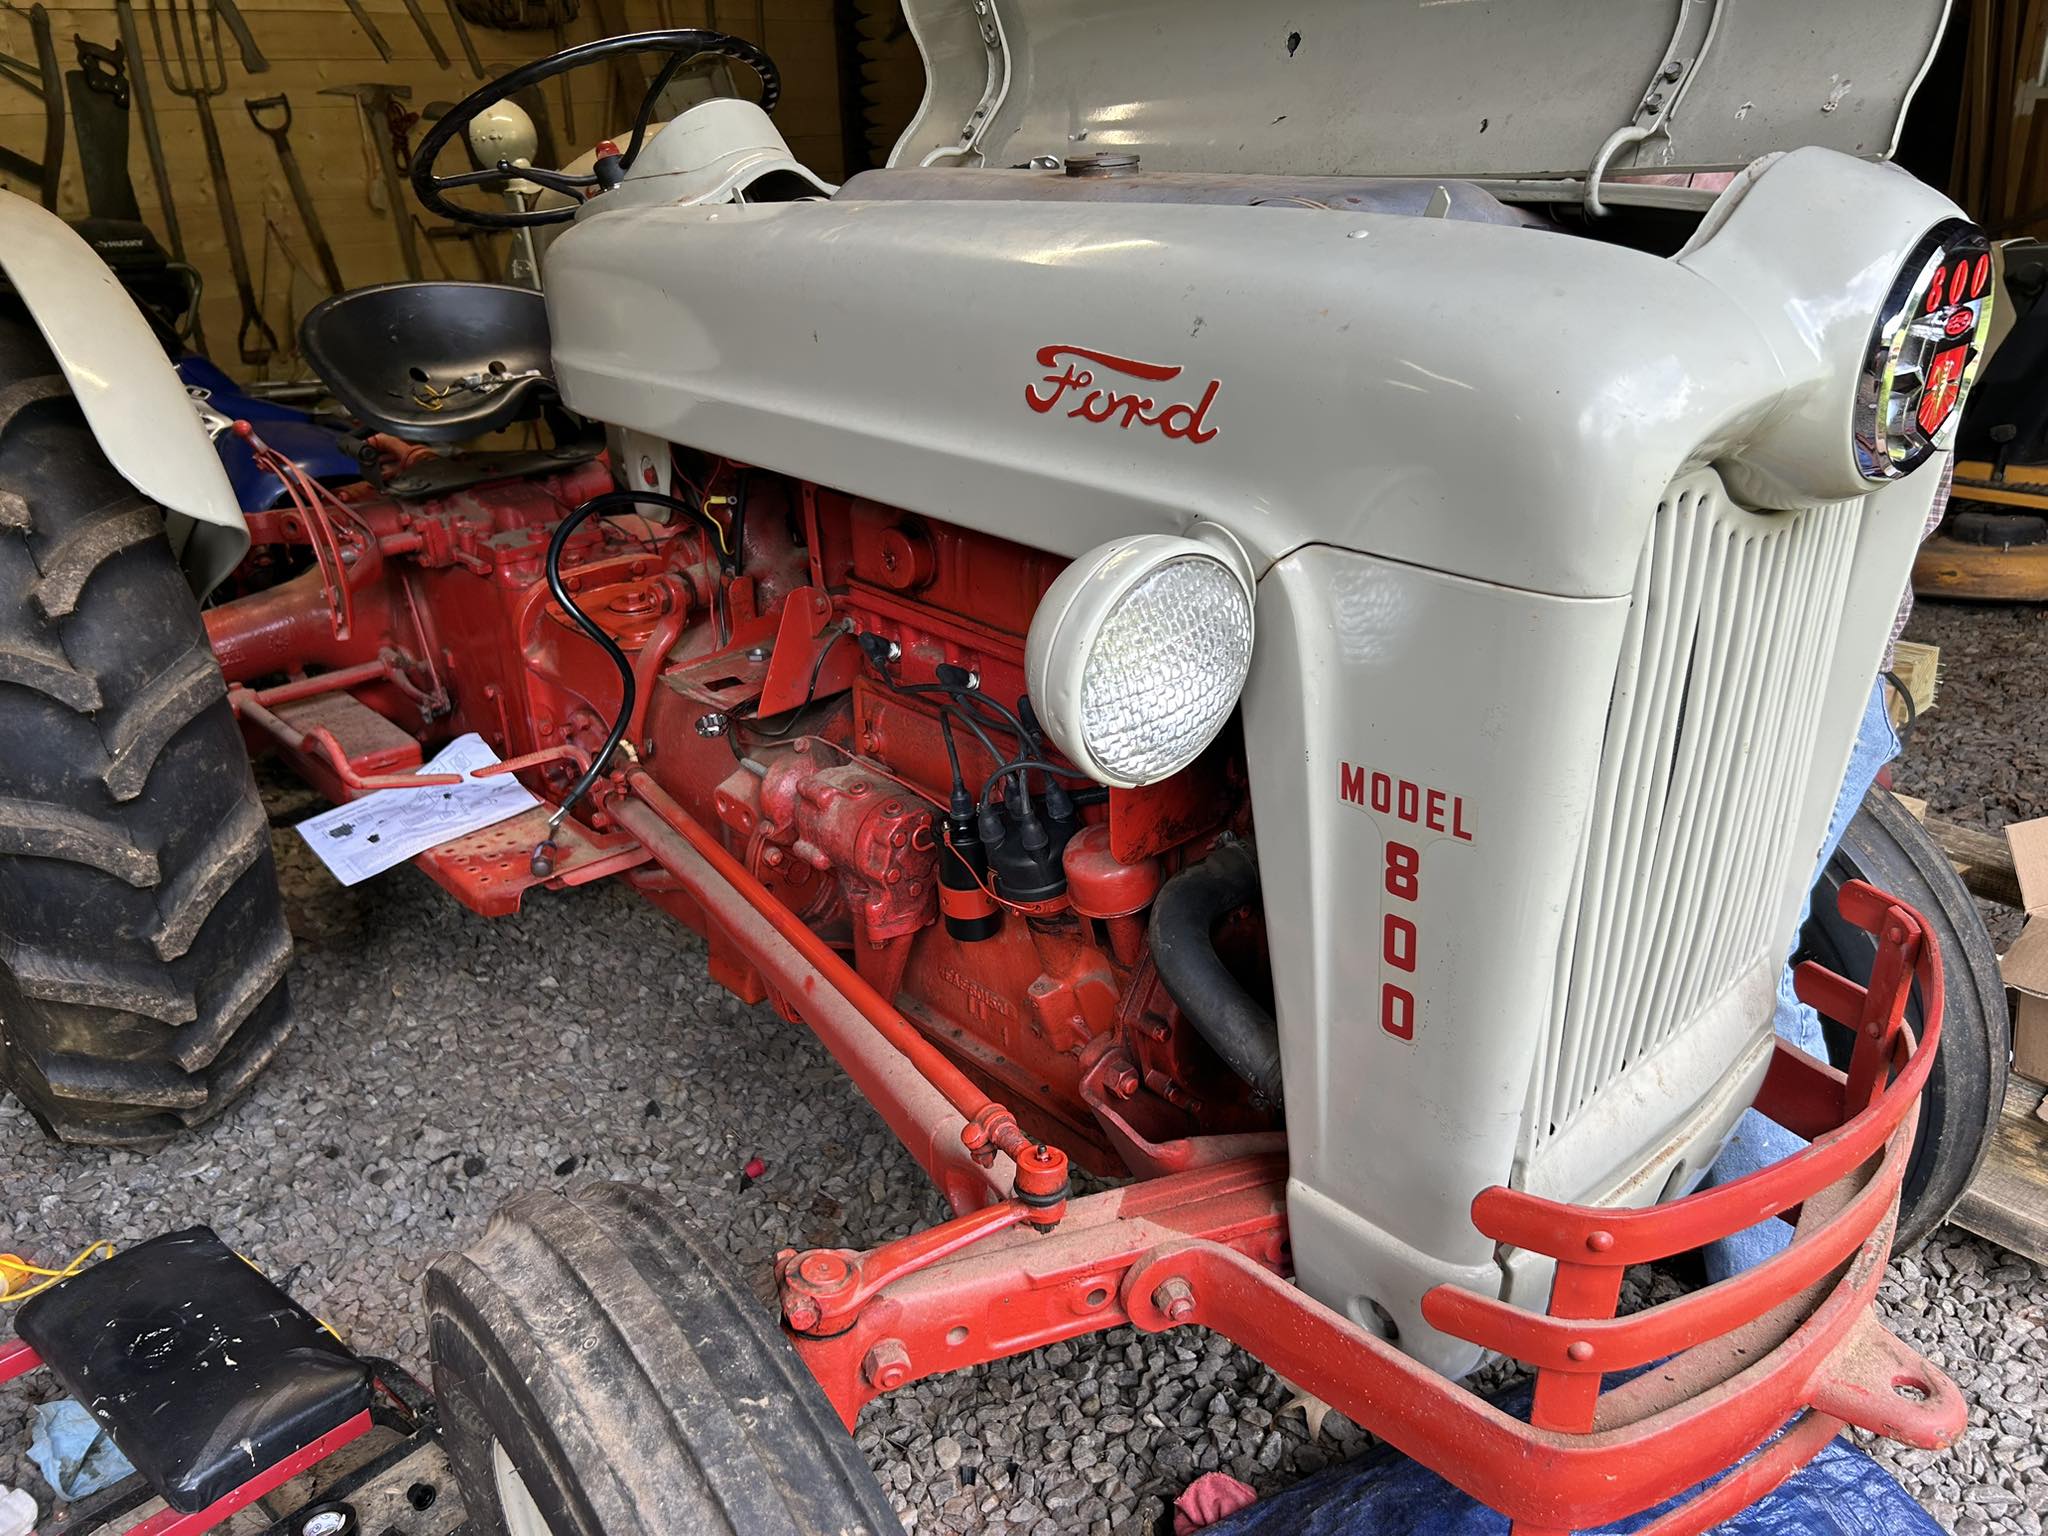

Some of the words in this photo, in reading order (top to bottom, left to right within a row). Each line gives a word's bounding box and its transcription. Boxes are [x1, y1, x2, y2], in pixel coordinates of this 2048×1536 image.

[107, 239, 143, 248] HUSKY
[1926, 254, 1989, 312] 800
[1025, 344, 1222, 444] Ford
[1340, 761, 1473, 841] MODEL
[1381, 840, 1420, 1041] 800
